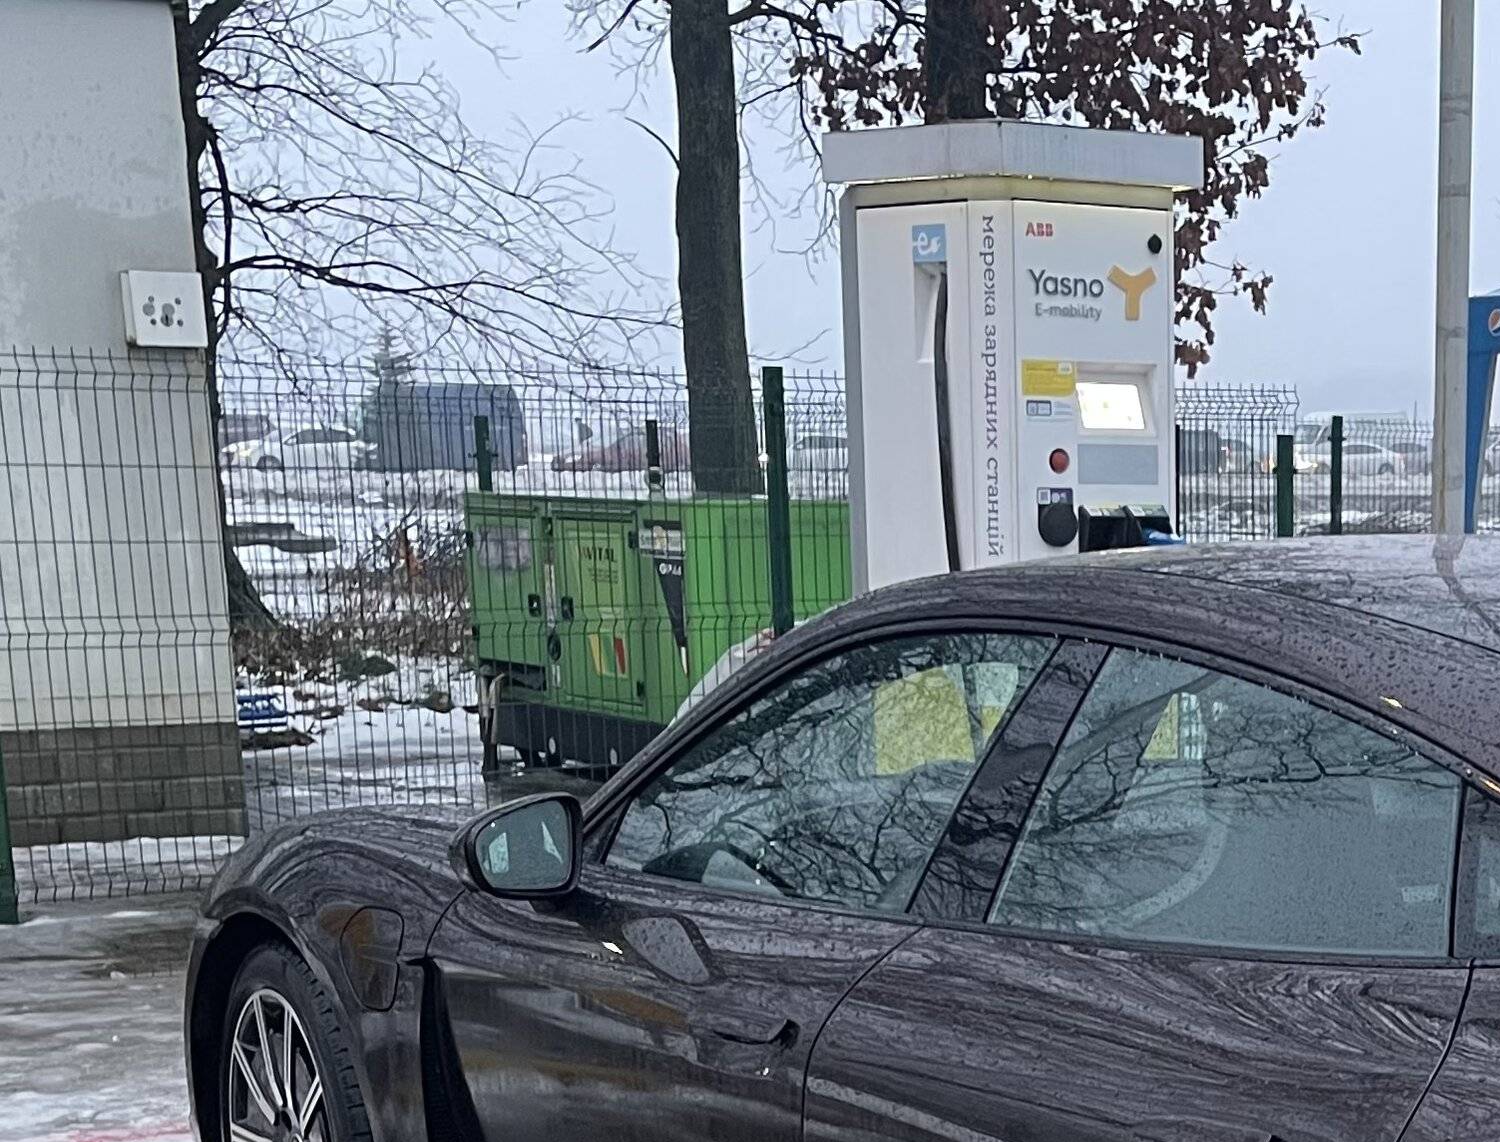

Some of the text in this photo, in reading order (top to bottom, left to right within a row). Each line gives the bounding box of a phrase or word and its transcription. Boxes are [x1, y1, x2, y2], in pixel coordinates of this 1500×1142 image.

[1025, 222, 1053, 237] ABB
[1027, 268, 1104, 298] Yasno
[1035, 303, 1102, 321] E-mobility
[979, 215, 1004, 557] мережа зарядних станцій
